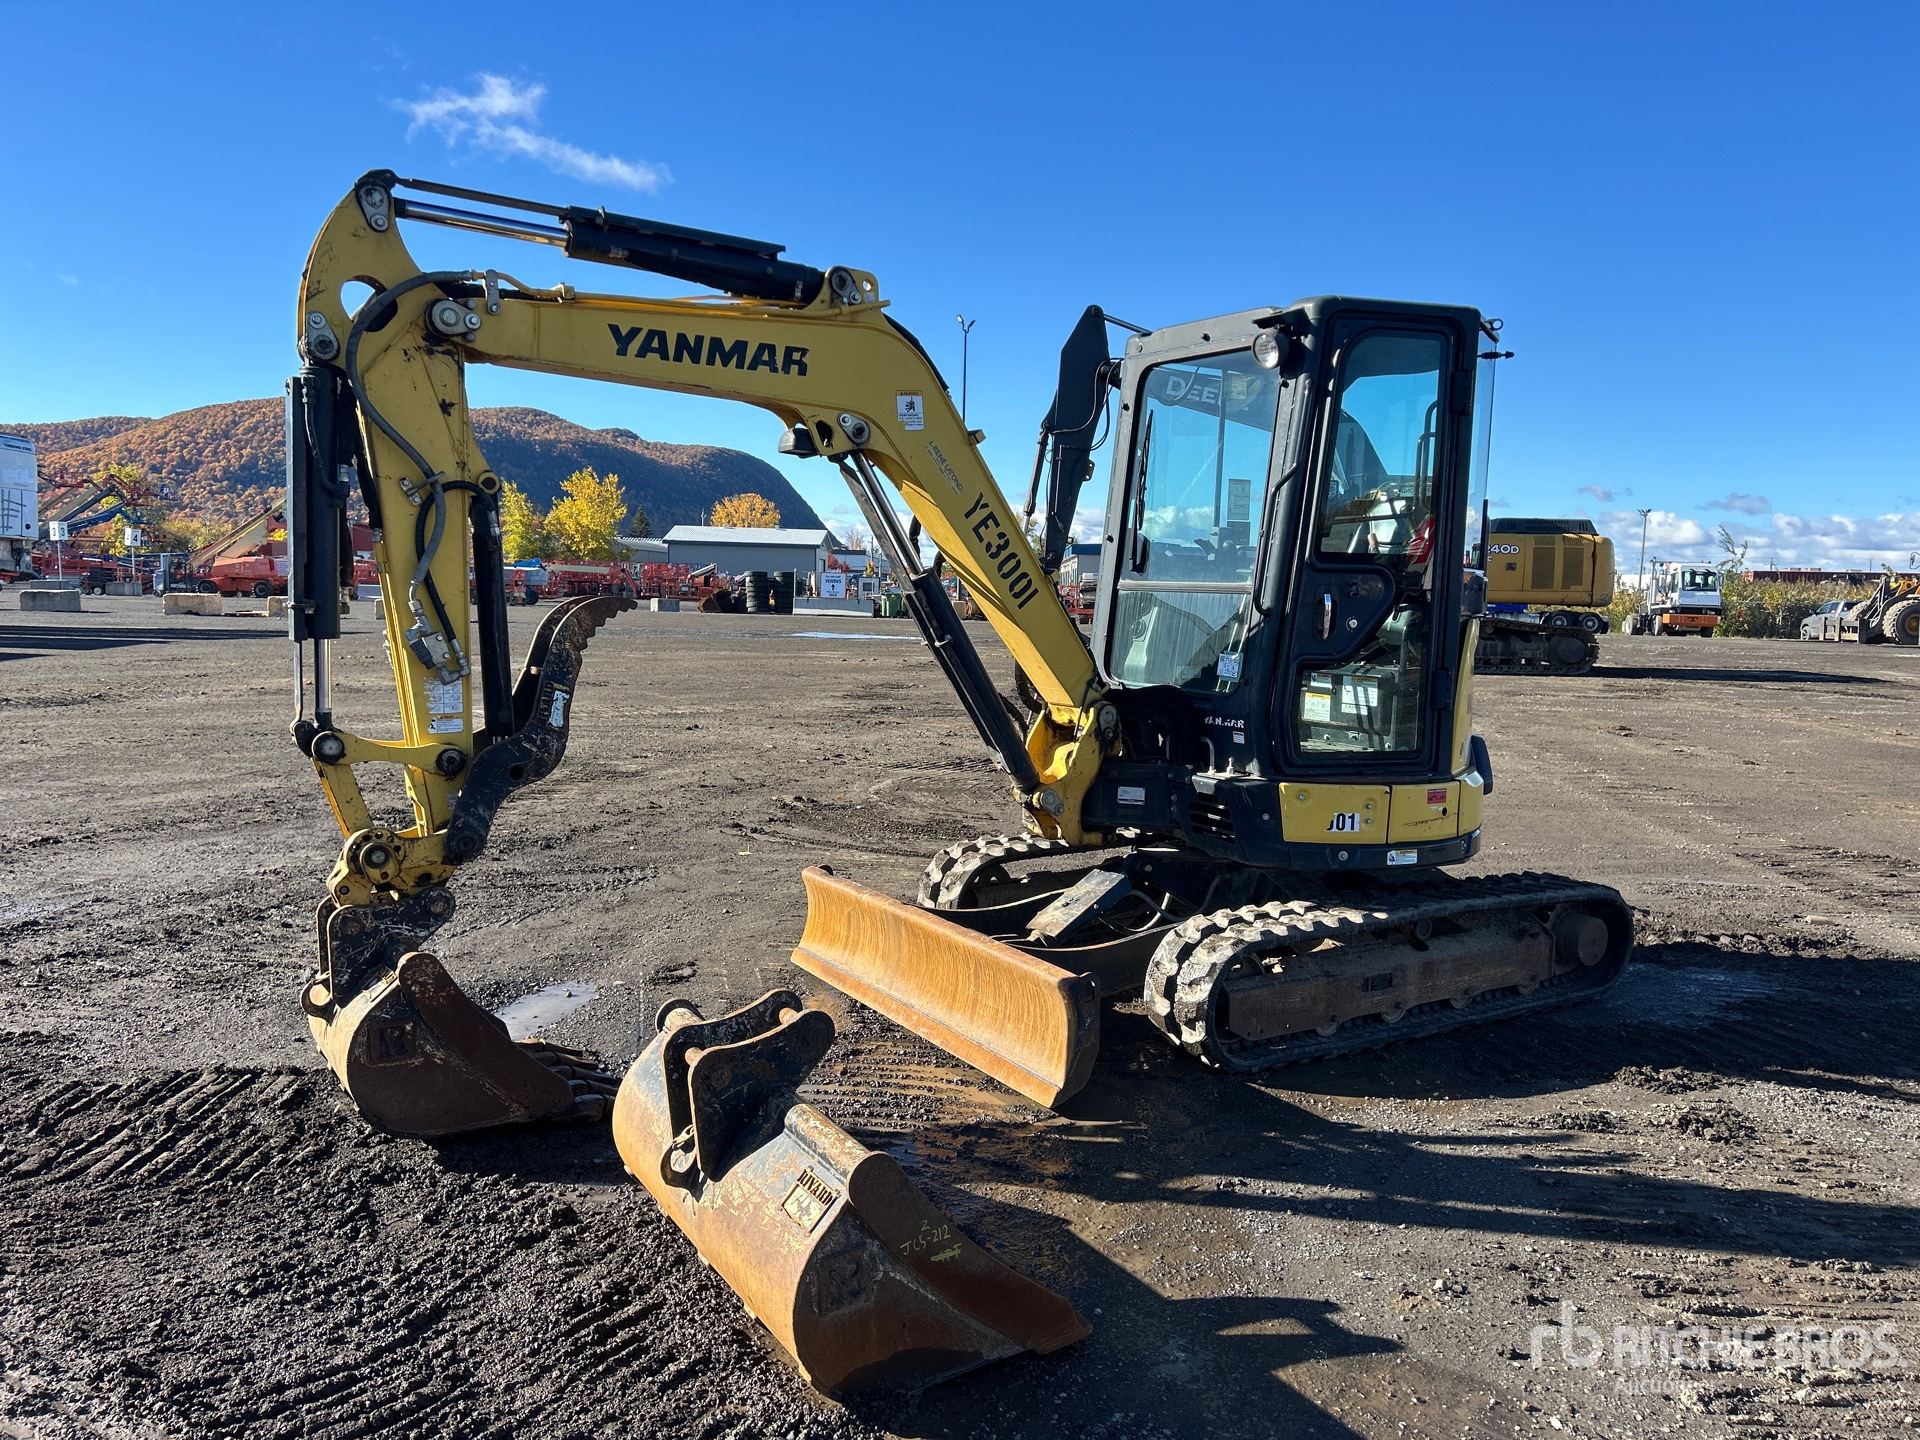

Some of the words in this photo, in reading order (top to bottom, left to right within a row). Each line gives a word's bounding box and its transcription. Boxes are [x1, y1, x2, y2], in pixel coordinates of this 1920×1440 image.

[607, 323, 810, 377] YANMAR
[52, 527, 57, 537] 3
[60, 527, 65, 536] 3
[132, 534, 138, 543] 4
[796, 1168, 834, 1206] RIVARD
